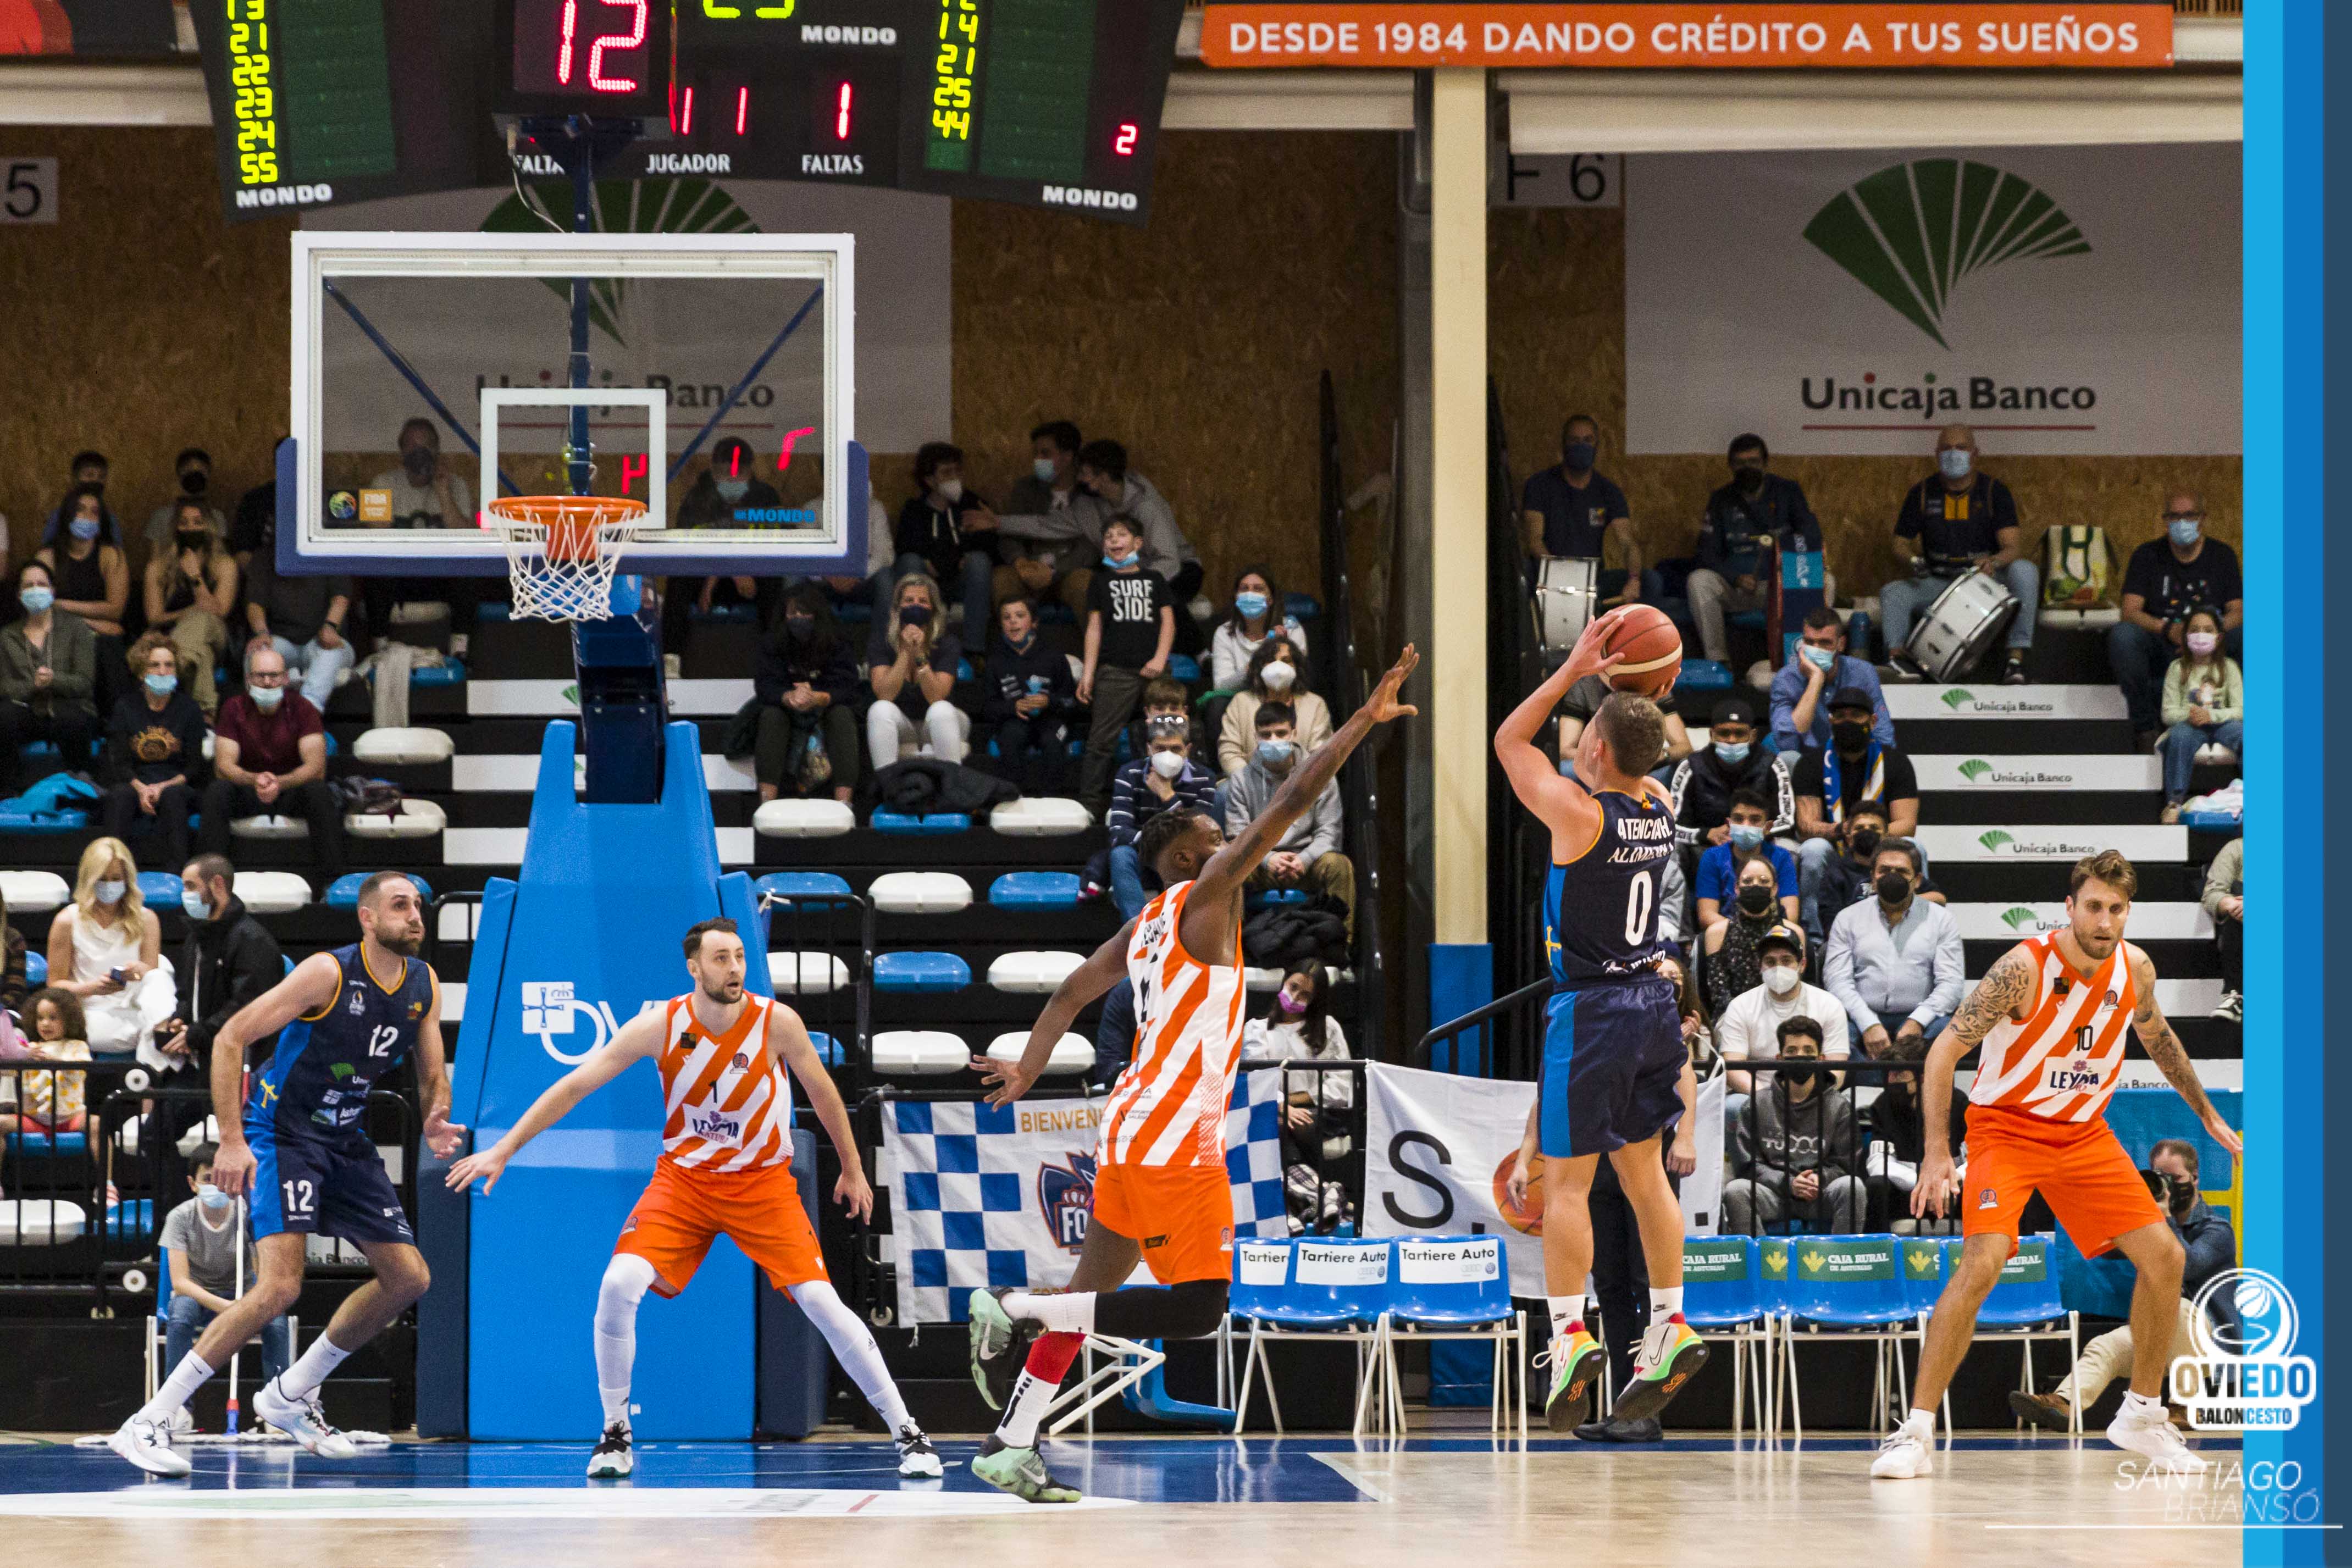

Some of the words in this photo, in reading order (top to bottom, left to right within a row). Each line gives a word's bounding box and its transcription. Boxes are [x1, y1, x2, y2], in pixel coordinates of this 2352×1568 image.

[230, 23, 267, 54] 21
[801, 25, 897, 46] MONDO
[939, 12, 978, 43] 14
[1230, 23, 1359, 53] DESDE
[1374, 23, 1466, 53] 1984
[1484, 23, 1636, 53] DANDO
[1651, 15, 1827, 53] CRÉDITO
[1842, 24, 1871, 52] A
[1891, 23, 1962, 52] TUS
[1977, 16, 2139, 53] SUEÑOS
[558, 0, 647, 92] 12
[936, 43, 976, 75] 21
[233, 54, 270, 86] 22
[235, 87, 273, 119] 23
[934, 76, 972, 108] 25
[837, 81, 852, 140] 1
[238, 120, 275, 152] 24
[933, 110, 970, 140] 44
[1114, 124, 1138, 156] 2
[240, 152, 279, 184] 55
[646, 154, 730, 173] JUGADOR
[801, 154, 864, 175] FALTAS
[1570, 153, 1606, 202] 6
[5, 163, 41, 217] 5
[236, 183, 333, 208] MONDO
[1043, 186, 1137, 210] MONDO
[1801, 372, 1961, 420] Unicaja
[1968, 377, 2096, 411] Banco
[748, 508, 815, 522] MONDO
[1109, 579, 1153, 597] SURF
[1113, 600, 1153, 621] SIDE
[1974, 701, 2016, 712] Unicaja
[2019, 701, 2054, 711] Banco
[1991, 772, 2034, 784] Unicaja
[2037, 773, 2072, 783] Banco
[2013, 843, 2057, 855] Unicaja
[2060, 844, 2095, 854] Banco
[1625, 871, 1652, 946] 0
[368, 1024, 399, 1057] 12
[2074, 1025, 2093, 1051] 10
[708, 1081, 717, 1104] 1
[1020, 1107, 1102, 1132] BIENVEN
[283, 1180, 314, 1212] 12
[1243, 1250, 1287, 1263] Tartier
[1302, 1250, 1355, 1263] Tartiere
[1360, 1251, 1386, 1262] Auto
[1402, 1249, 1456, 1261] Tartiere
[1462, 1248, 1495, 1259] Auto
[1708, 1253, 1742, 1264] RURAL
[1828, 1255, 1853, 1264] CAJA
[1855, 1253, 1889, 1263] RURAL
